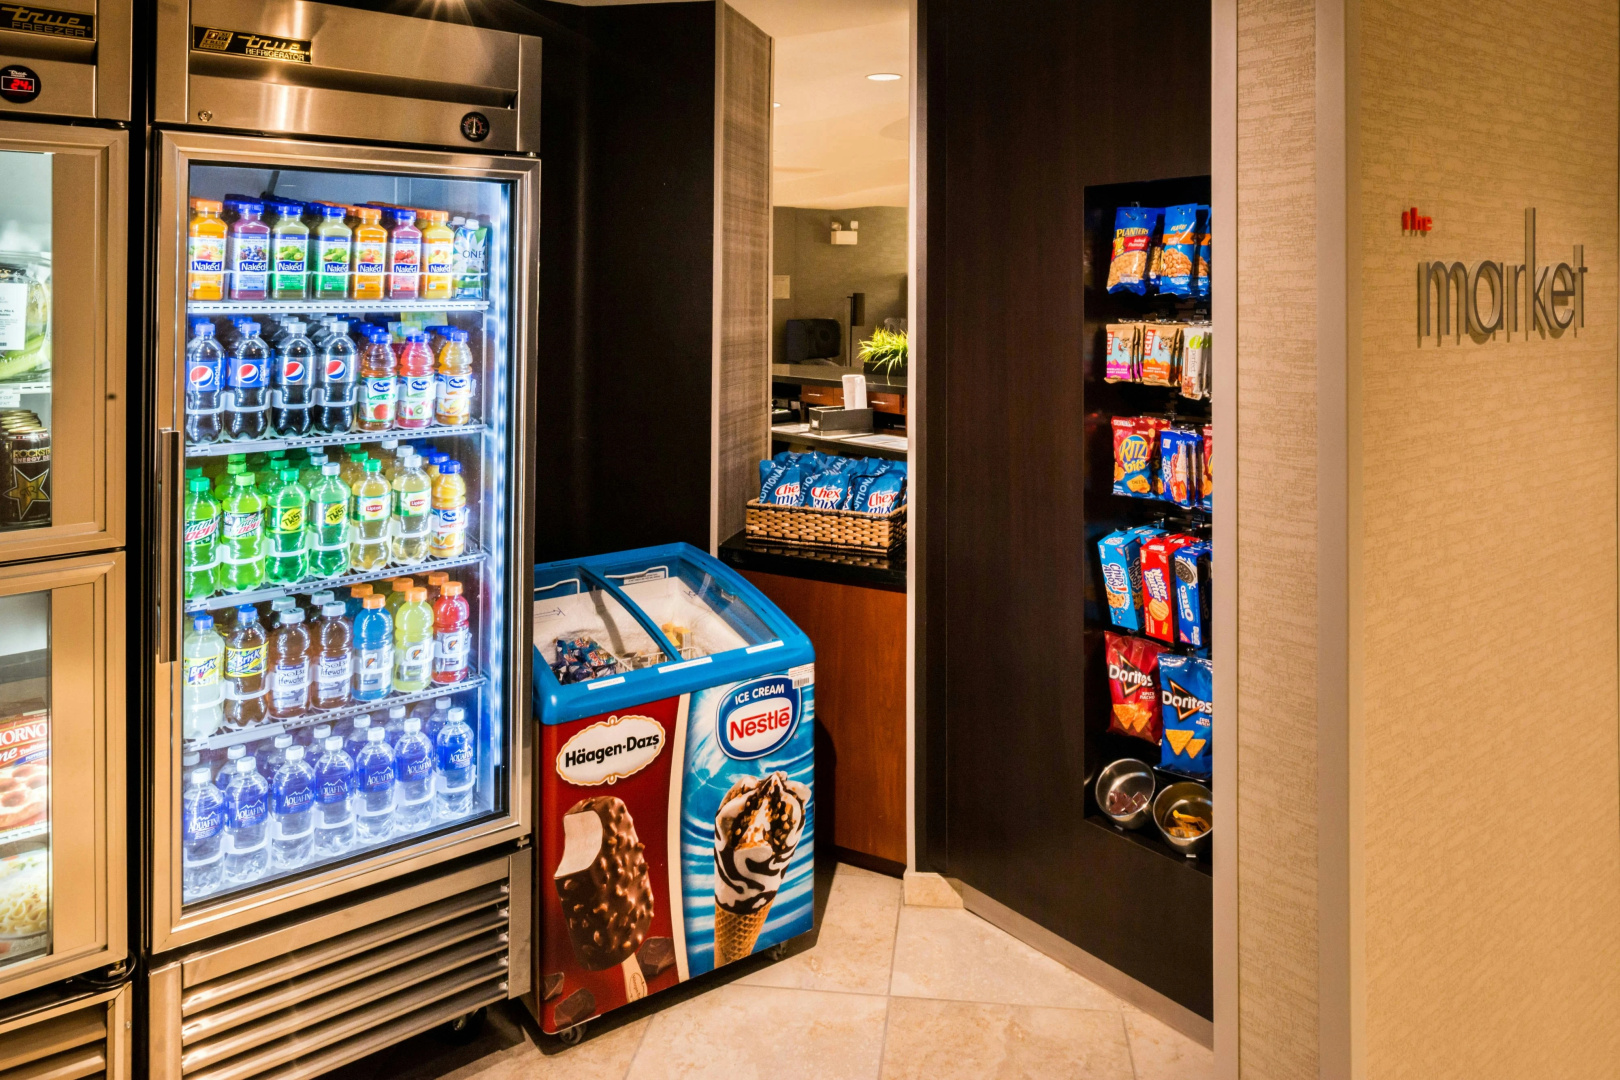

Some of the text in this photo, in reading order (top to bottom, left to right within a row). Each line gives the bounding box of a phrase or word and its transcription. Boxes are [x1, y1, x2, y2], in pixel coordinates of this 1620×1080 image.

[1, 7, 86, 30] true
[12, 21, 86, 37] FREEZER
[237, 35, 305, 54] true
[245, 47, 305, 61] REFRIGERATOR
[1402, 207, 1432, 231] the
[1116, 227, 1149, 238] PLANTERS
[462, 250, 483, 259] ONE
[194, 262, 220, 271] Naked
[241, 262, 267, 271] Naked
[278, 262, 303, 271] Naked
[359, 264, 383, 273] Naked
[396, 265, 418, 273] Naked
[1418, 207, 1588, 336] market
[1120, 438, 1149, 462] RITZ
[1124, 460, 1146, 473] bits
[812, 487, 842, 499] Chex
[869, 493, 898, 507] Chex
[1144, 571, 1162, 602] Butter
[1152, 568, 1168, 600] Nutter
[1181, 585, 1194, 621] OREO
[190, 658, 216, 676] Brisk
[1109, 664, 1154, 687] Doritos
[735, 684, 785, 705] ICE CREAM
[1162, 690, 1212, 714] Doritos
[730, 706, 790, 741] Nestlé
[565, 734, 660, 768] Häagen-Dazs
[322, 781, 348, 796] QUAFINA
[284, 792, 313, 807] AQUAFIN
